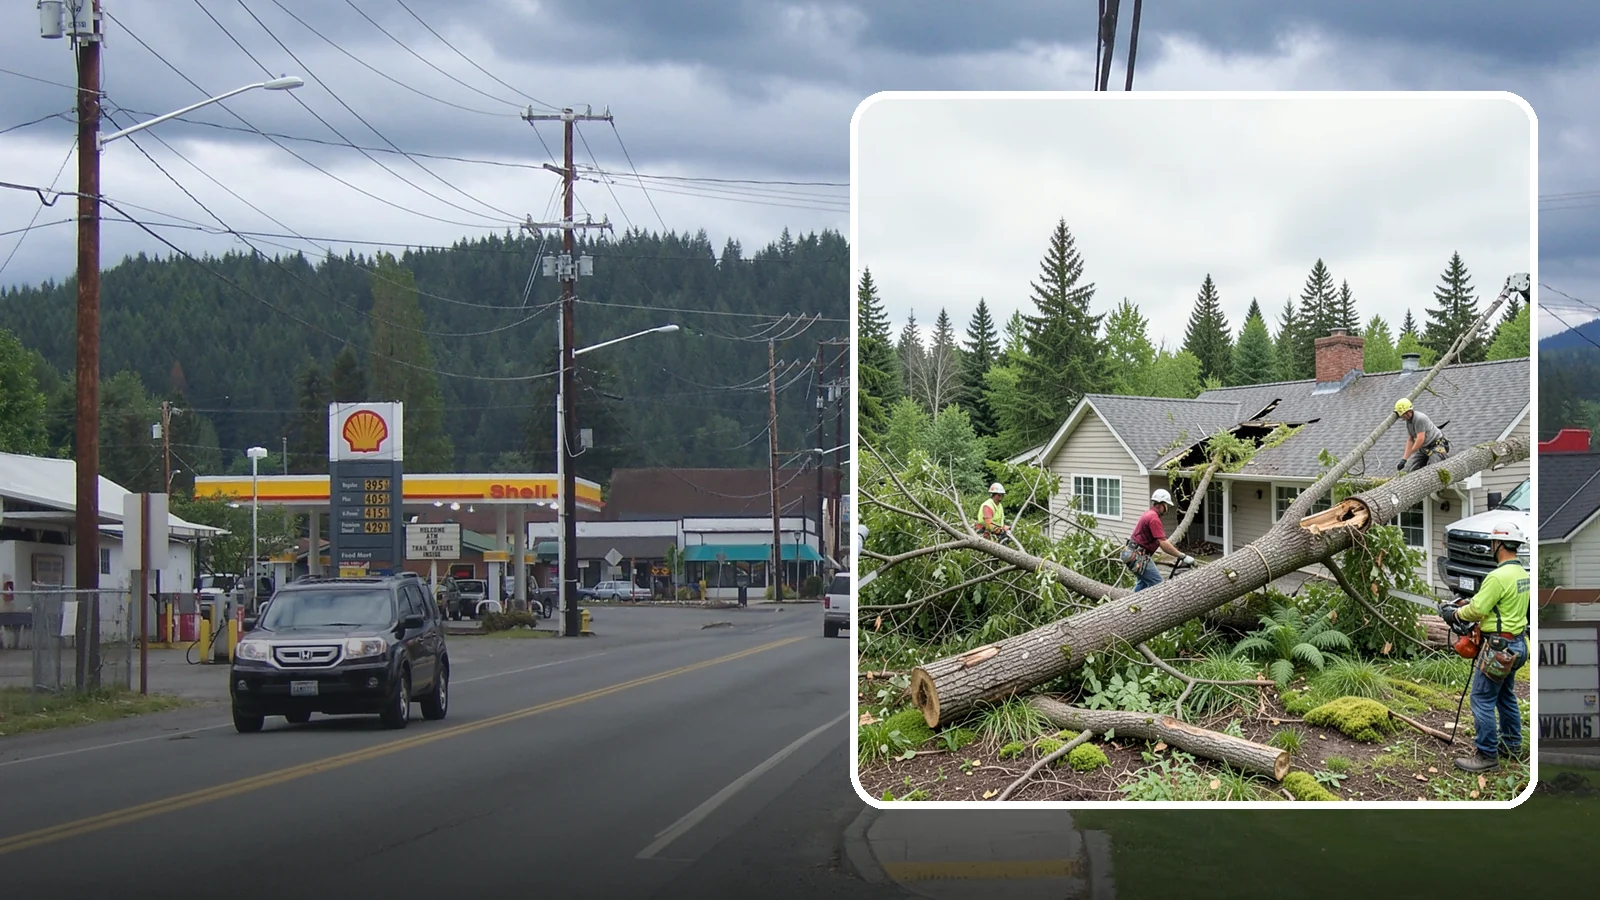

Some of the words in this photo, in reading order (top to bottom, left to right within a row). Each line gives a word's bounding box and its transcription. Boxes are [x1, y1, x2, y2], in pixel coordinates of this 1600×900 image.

[366, 480, 383, 490] 395
[490, 484, 547, 499] Shell
[366, 494, 383, 504] 405
[366, 508, 383, 518] 415
[366, 522, 383, 532] 429
[1538, 643, 1567, 665] AID
